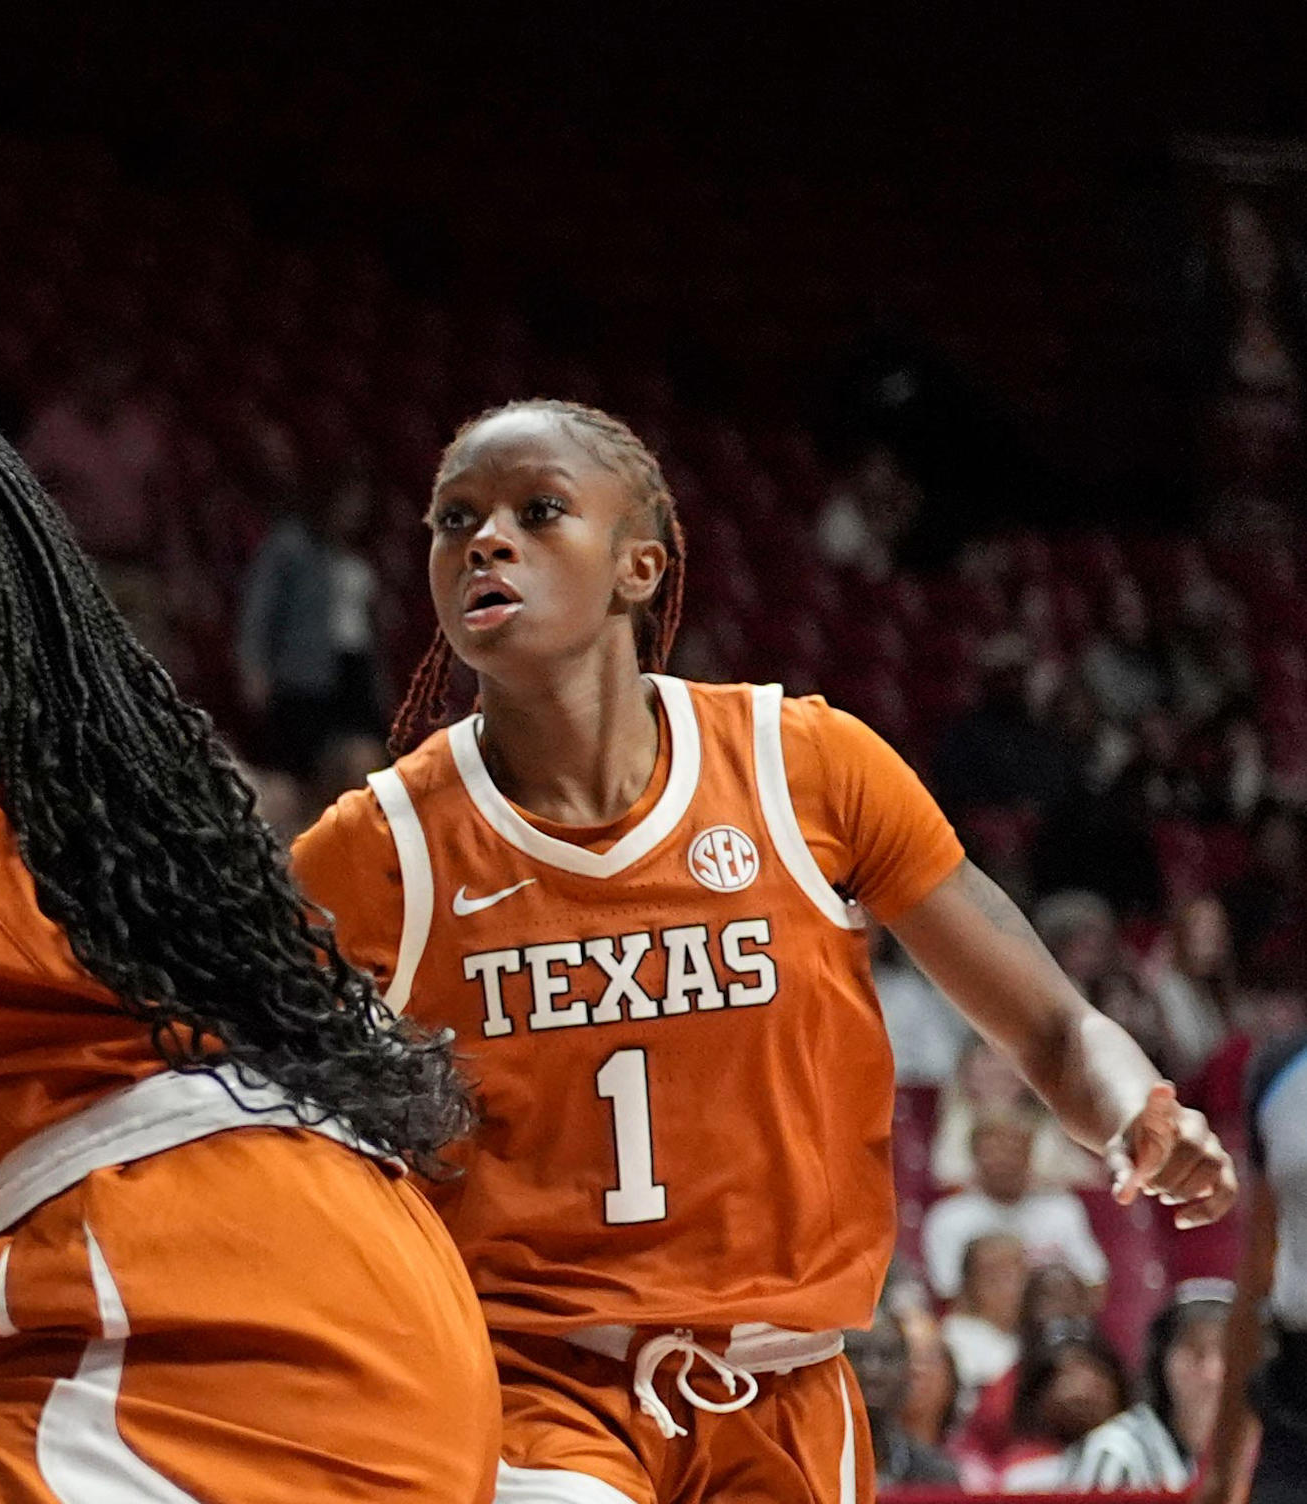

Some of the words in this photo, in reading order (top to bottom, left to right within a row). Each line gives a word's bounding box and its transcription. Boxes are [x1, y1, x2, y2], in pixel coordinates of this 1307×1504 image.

[690, 827, 758, 891] SEC
[462, 917, 779, 1038] TEXAS
[595, 1047, 667, 1226] 1
